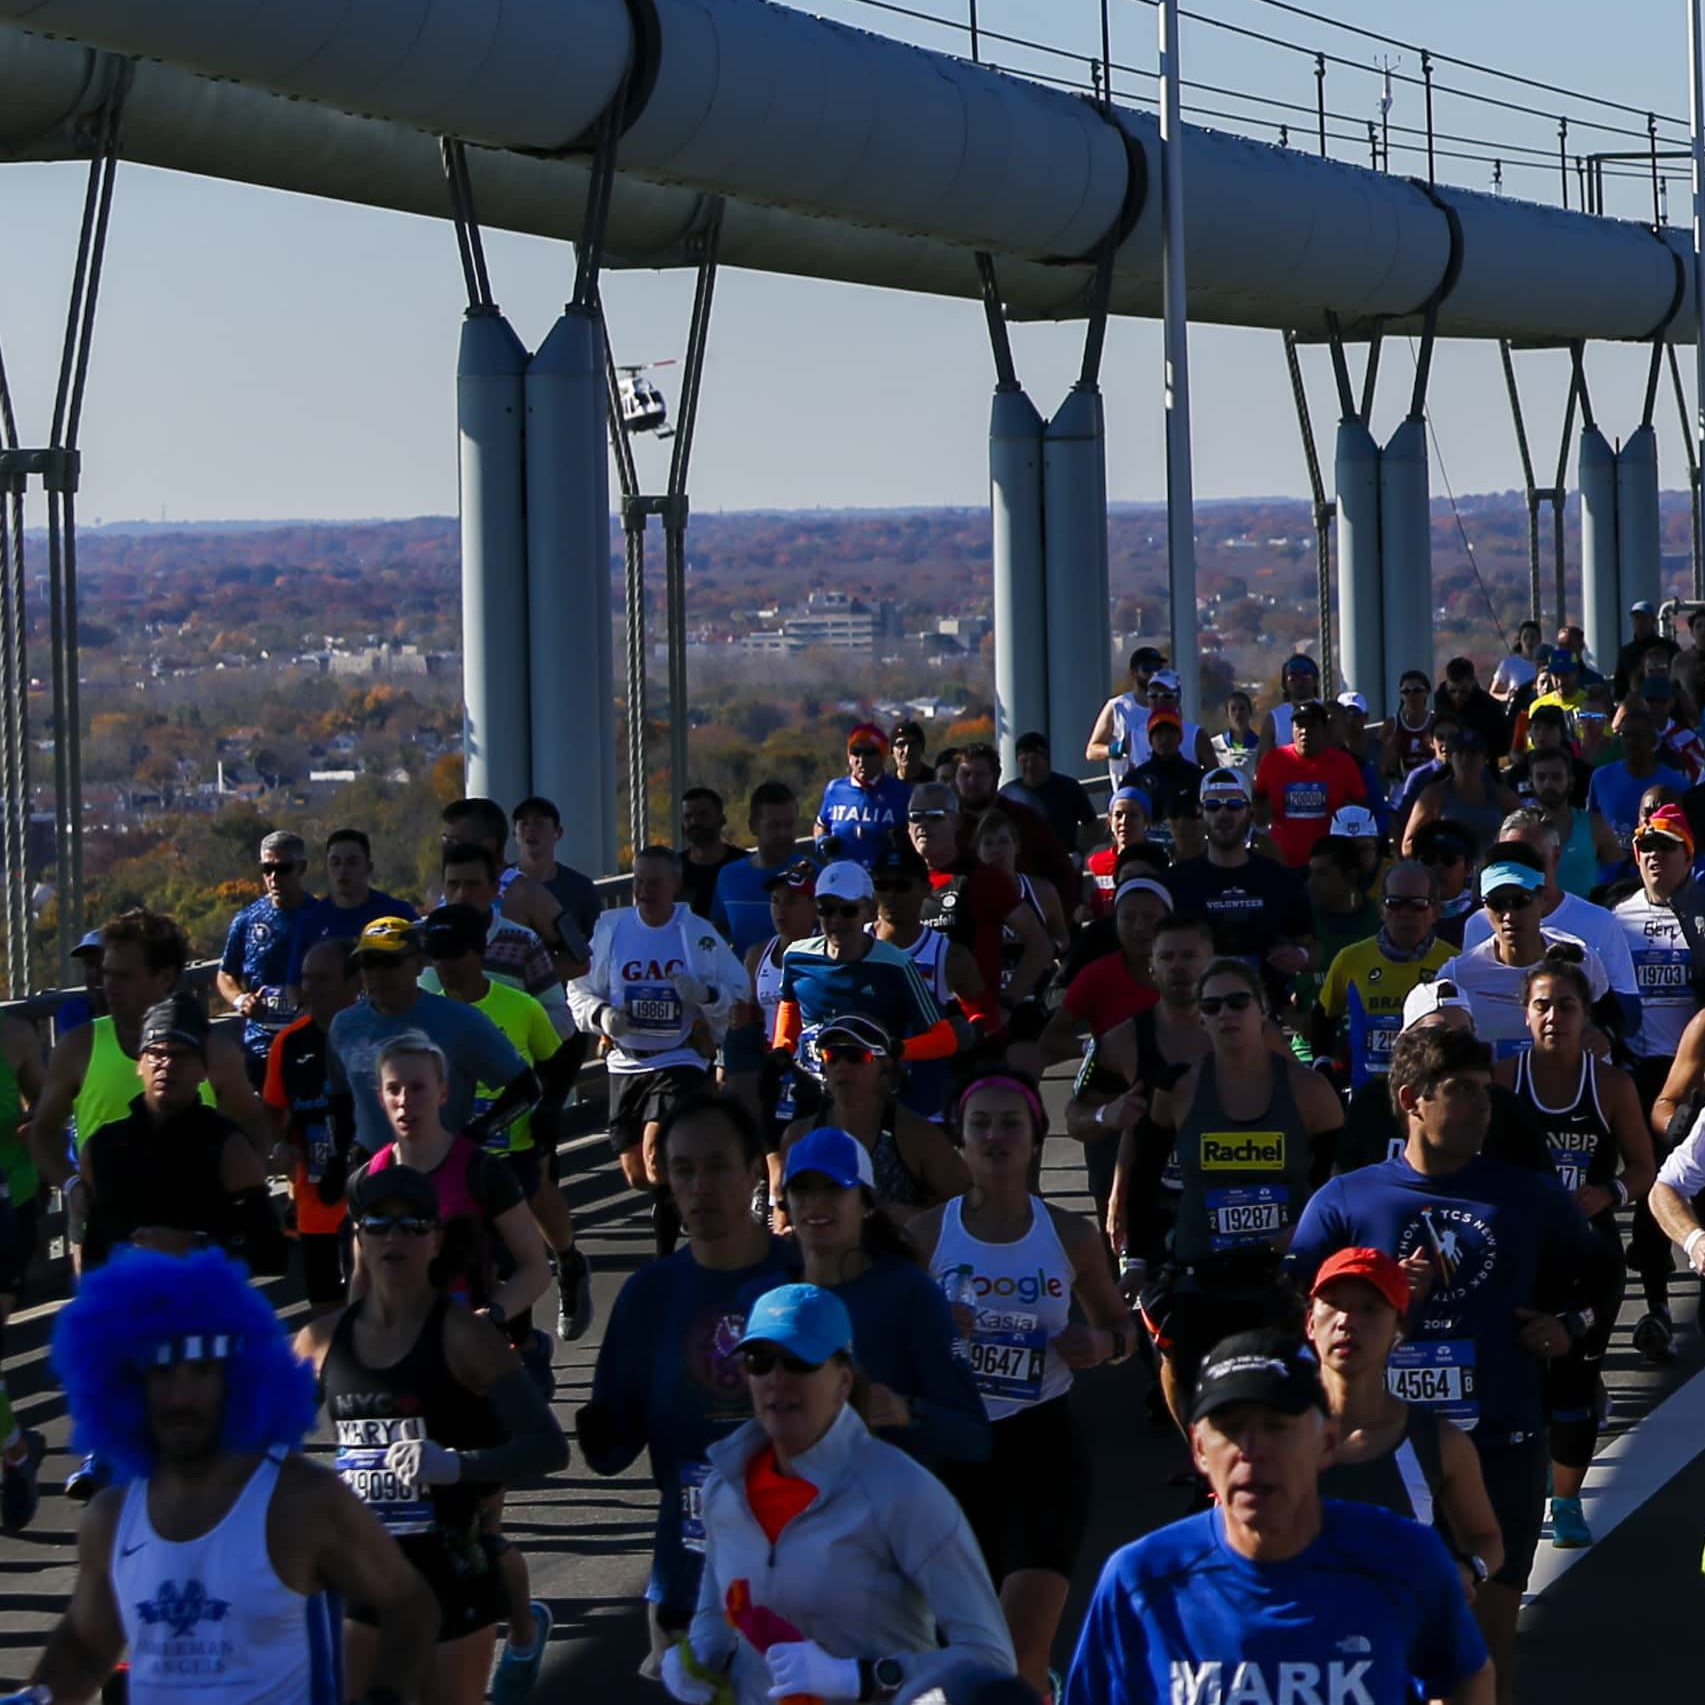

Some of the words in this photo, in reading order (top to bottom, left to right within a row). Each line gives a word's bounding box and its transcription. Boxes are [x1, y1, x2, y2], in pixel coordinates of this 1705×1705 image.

[832, 803, 895, 824] ITALIA
[1206, 898, 1264, 911] VOLUNTEER
[1641, 965, 1683, 985] 19703
[634, 996, 675, 1020] 19861
[1201, 1138, 1283, 1164] Rachel
[1208, 1210, 1218, 1229] 2
[1222, 1204, 1281, 1234] 19287
[1280, 1209, 1289, 1224] A
[1440, 1207, 1472, 1223] TCS
[975, 1311, 1036, 1332] Kasia
[1031, 1356, 1042, 1376] A
[335, 1393, 393, 1415] NYC
[1168, 1660, 1376, 1705] MARK
